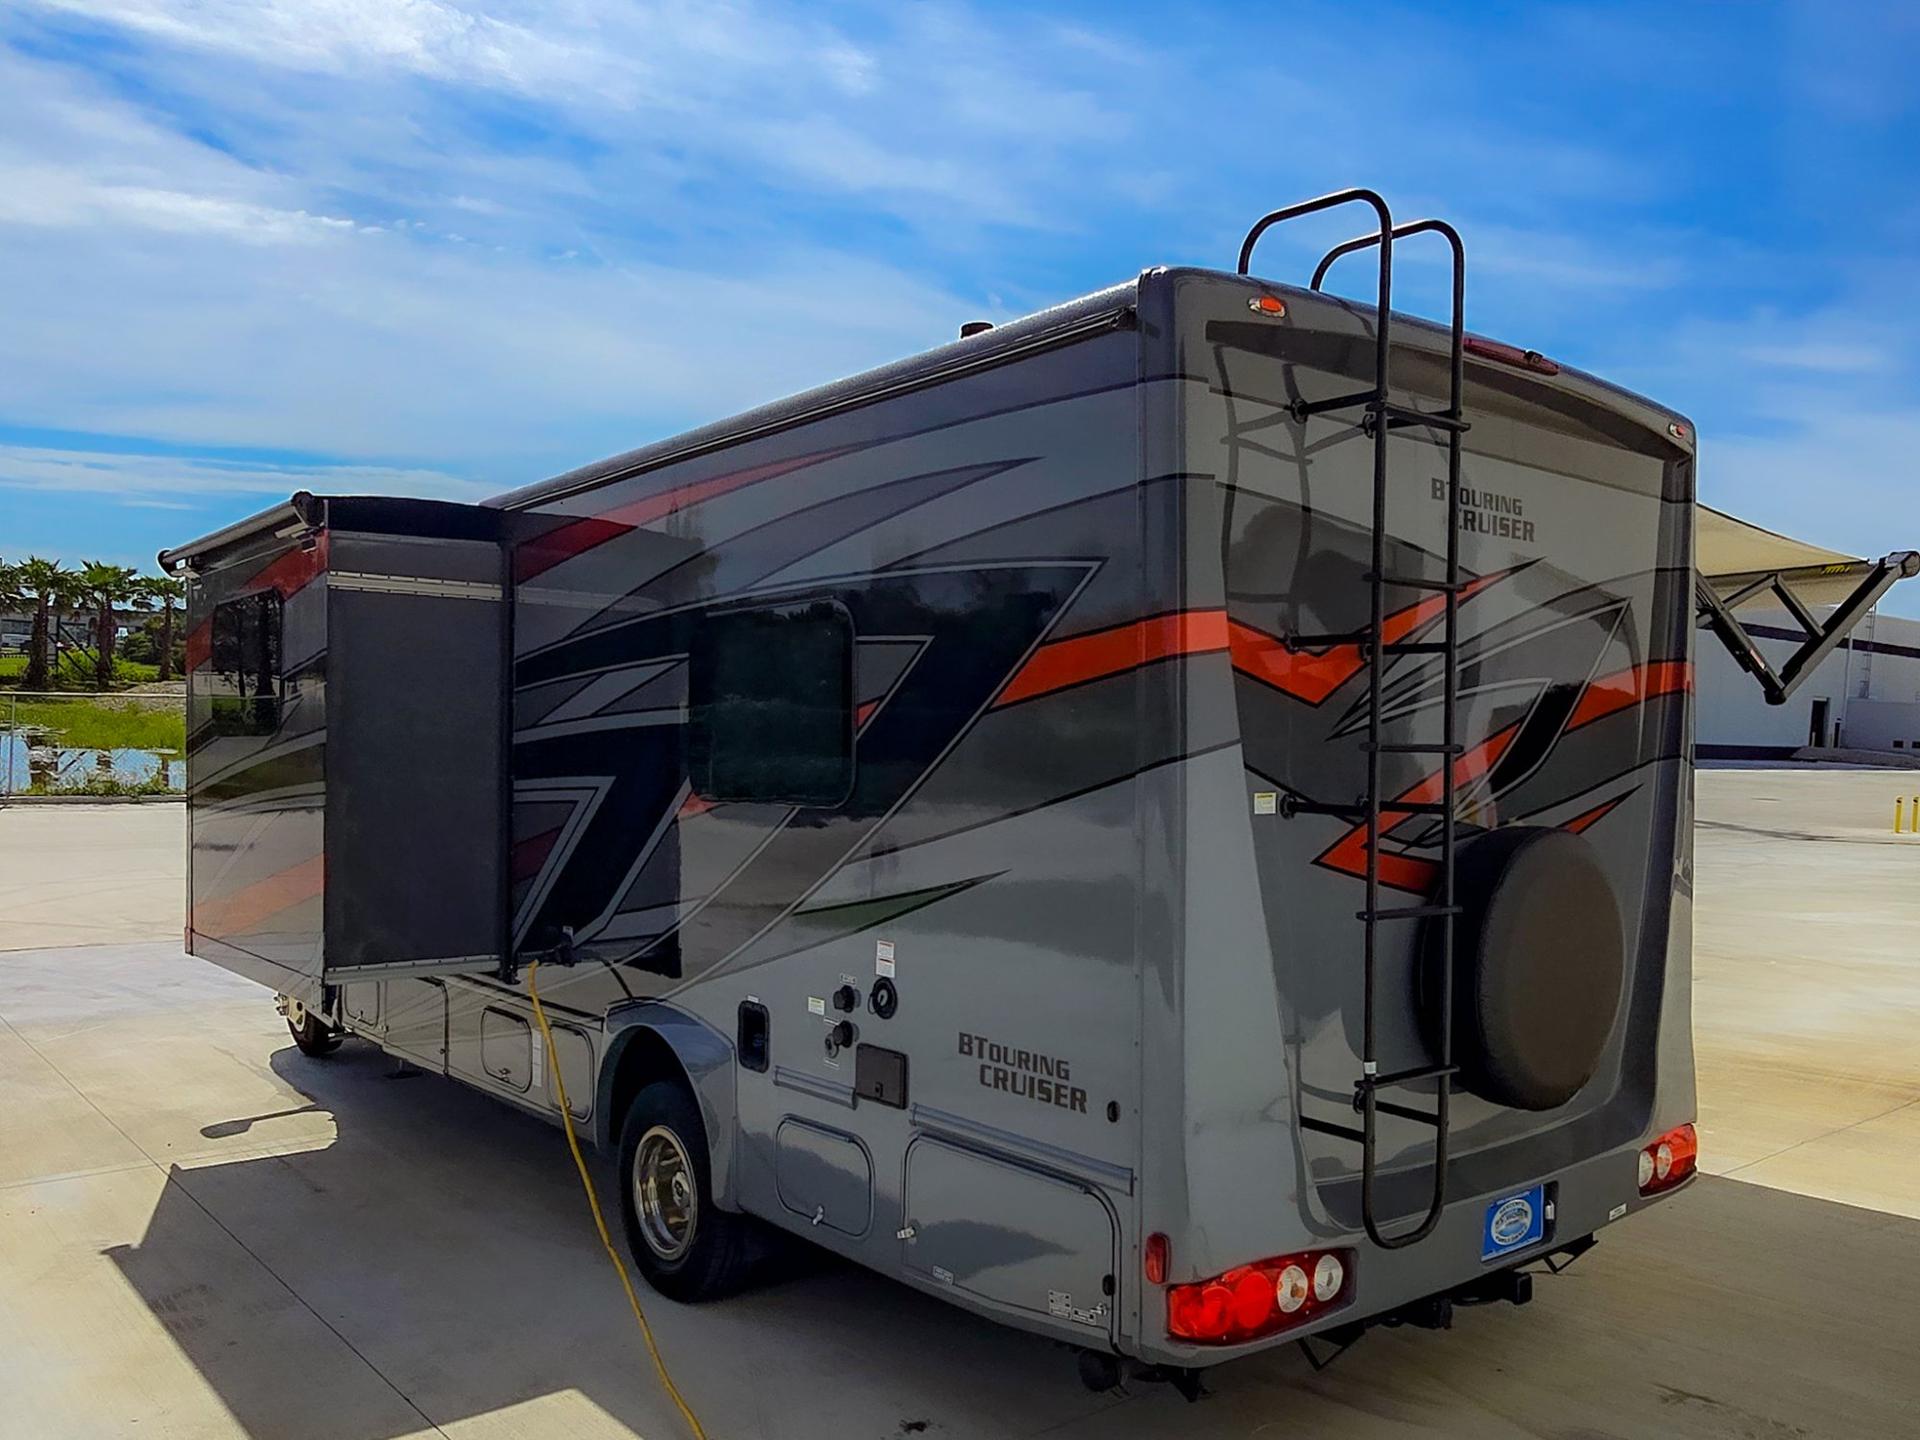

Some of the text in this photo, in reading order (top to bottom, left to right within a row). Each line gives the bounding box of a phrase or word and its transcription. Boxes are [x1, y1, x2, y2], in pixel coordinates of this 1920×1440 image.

[1431, 478, 1523, 516] BOURING
[1457, 509, 1535, 543] RUISER
[958, 1032, 1070, 1081] BTOURING
[979, 1064, 1087, 1114] CRUISER
